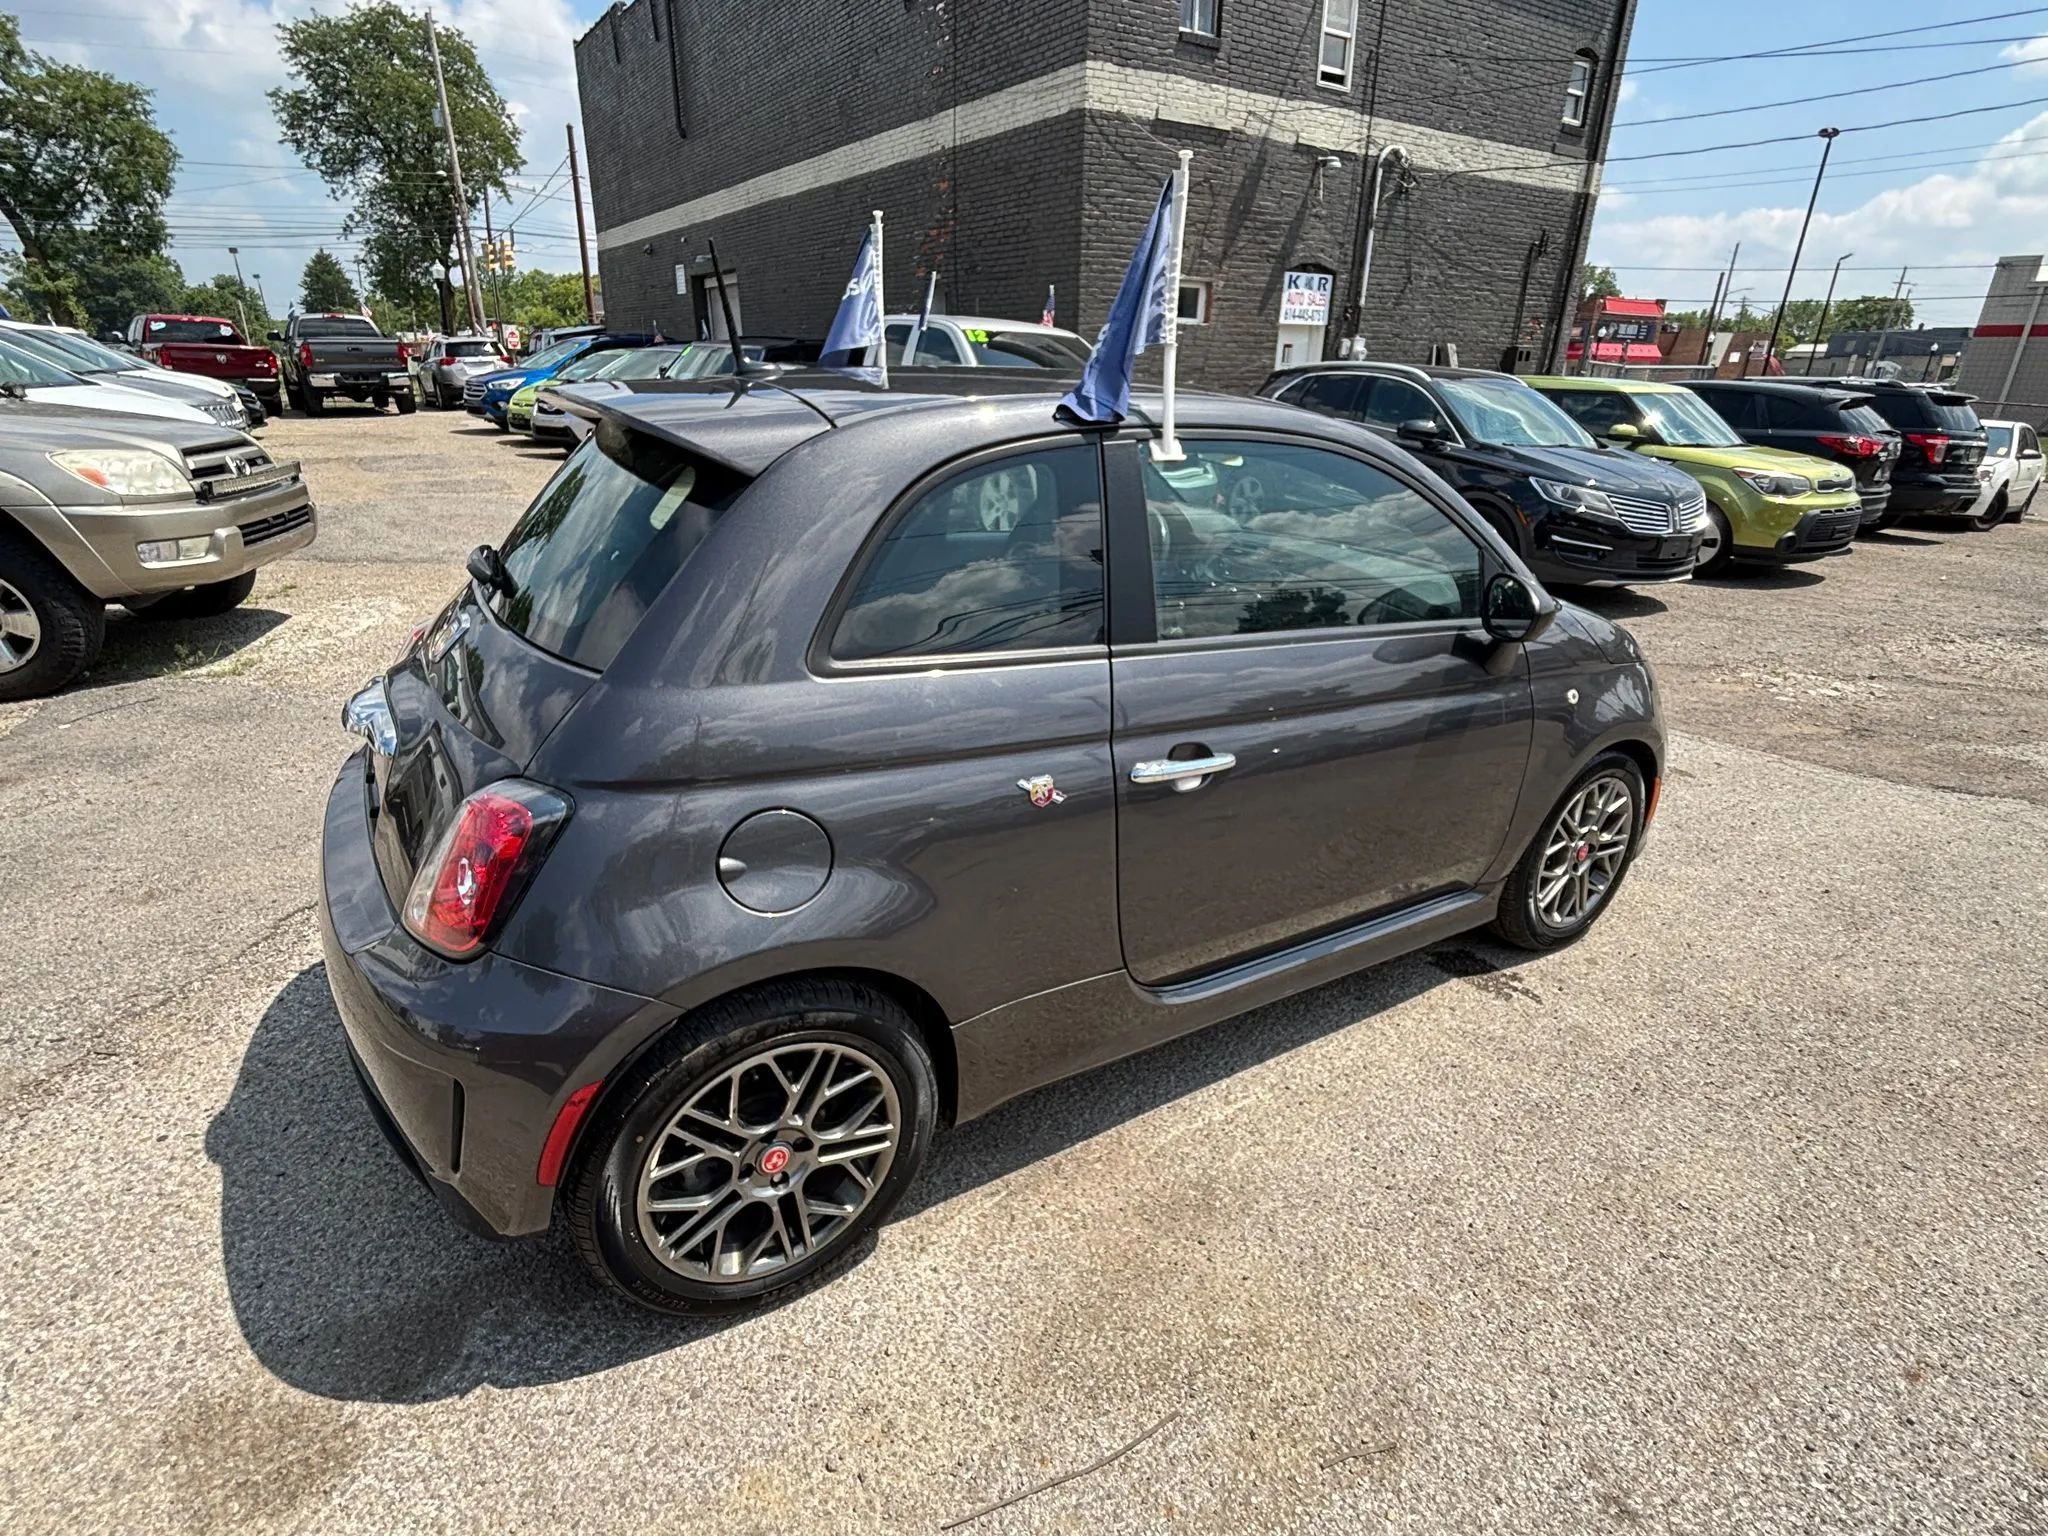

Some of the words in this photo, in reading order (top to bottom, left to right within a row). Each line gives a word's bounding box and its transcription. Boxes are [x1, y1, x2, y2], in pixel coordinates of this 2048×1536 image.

[1287, 274, 1301, 290] K
[1317, 276, 1329, 291] R
[1286, 291, 1305, 306] AUTO
[1307, 292, 1327, 307] SALES
